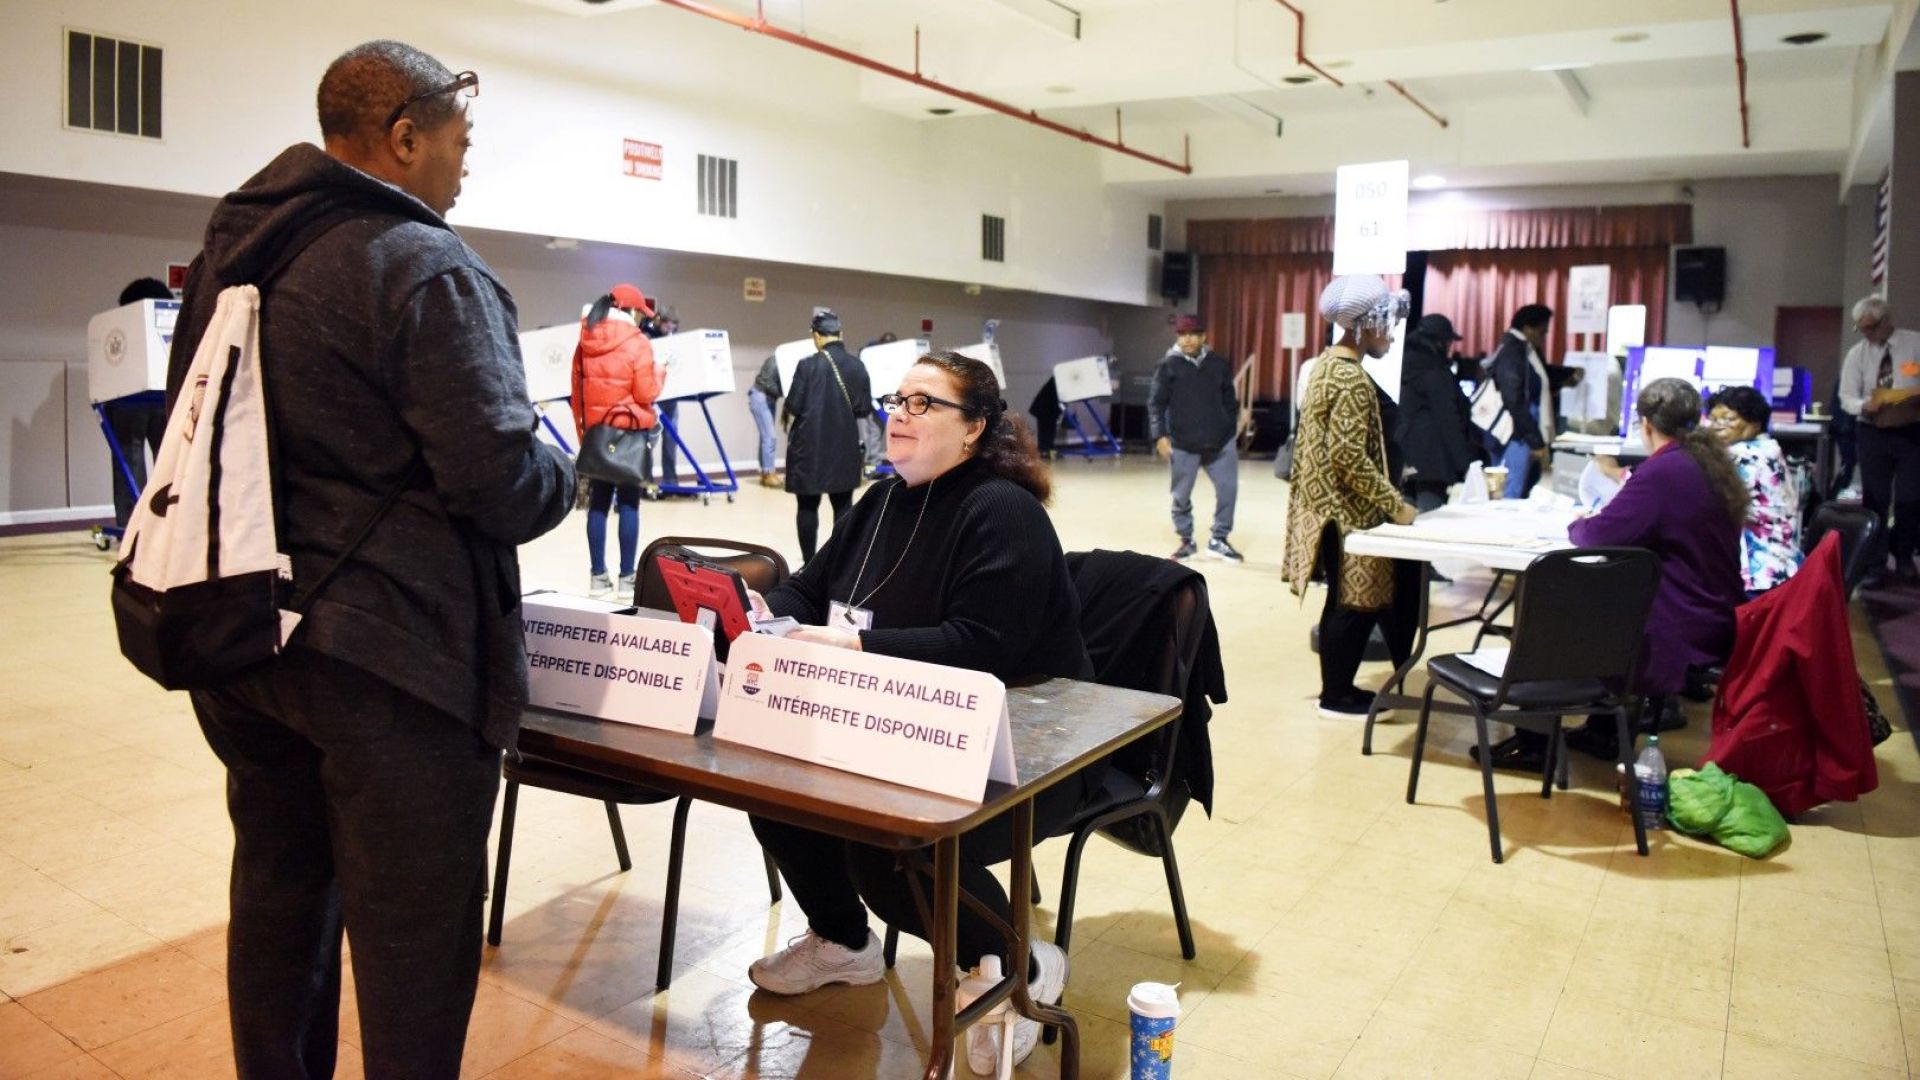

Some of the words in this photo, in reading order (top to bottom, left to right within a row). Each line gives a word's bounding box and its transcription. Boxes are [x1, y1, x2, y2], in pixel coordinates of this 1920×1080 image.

[1360, 220, 1380, 237] 61
[523, 620, 608, 645] NTERPRETER
[611, 632, 692, 657] AVAILABLE
[594, 664, 684, 691] DISPONIBLE
[774, 658, 879, 691] INTERPRETER
[883, 679, 979, 711] AVAILABLE
[767, 694, 861, 727] INTÉRPRETE
[864, 714, 969, 750] DISPONIBLE
